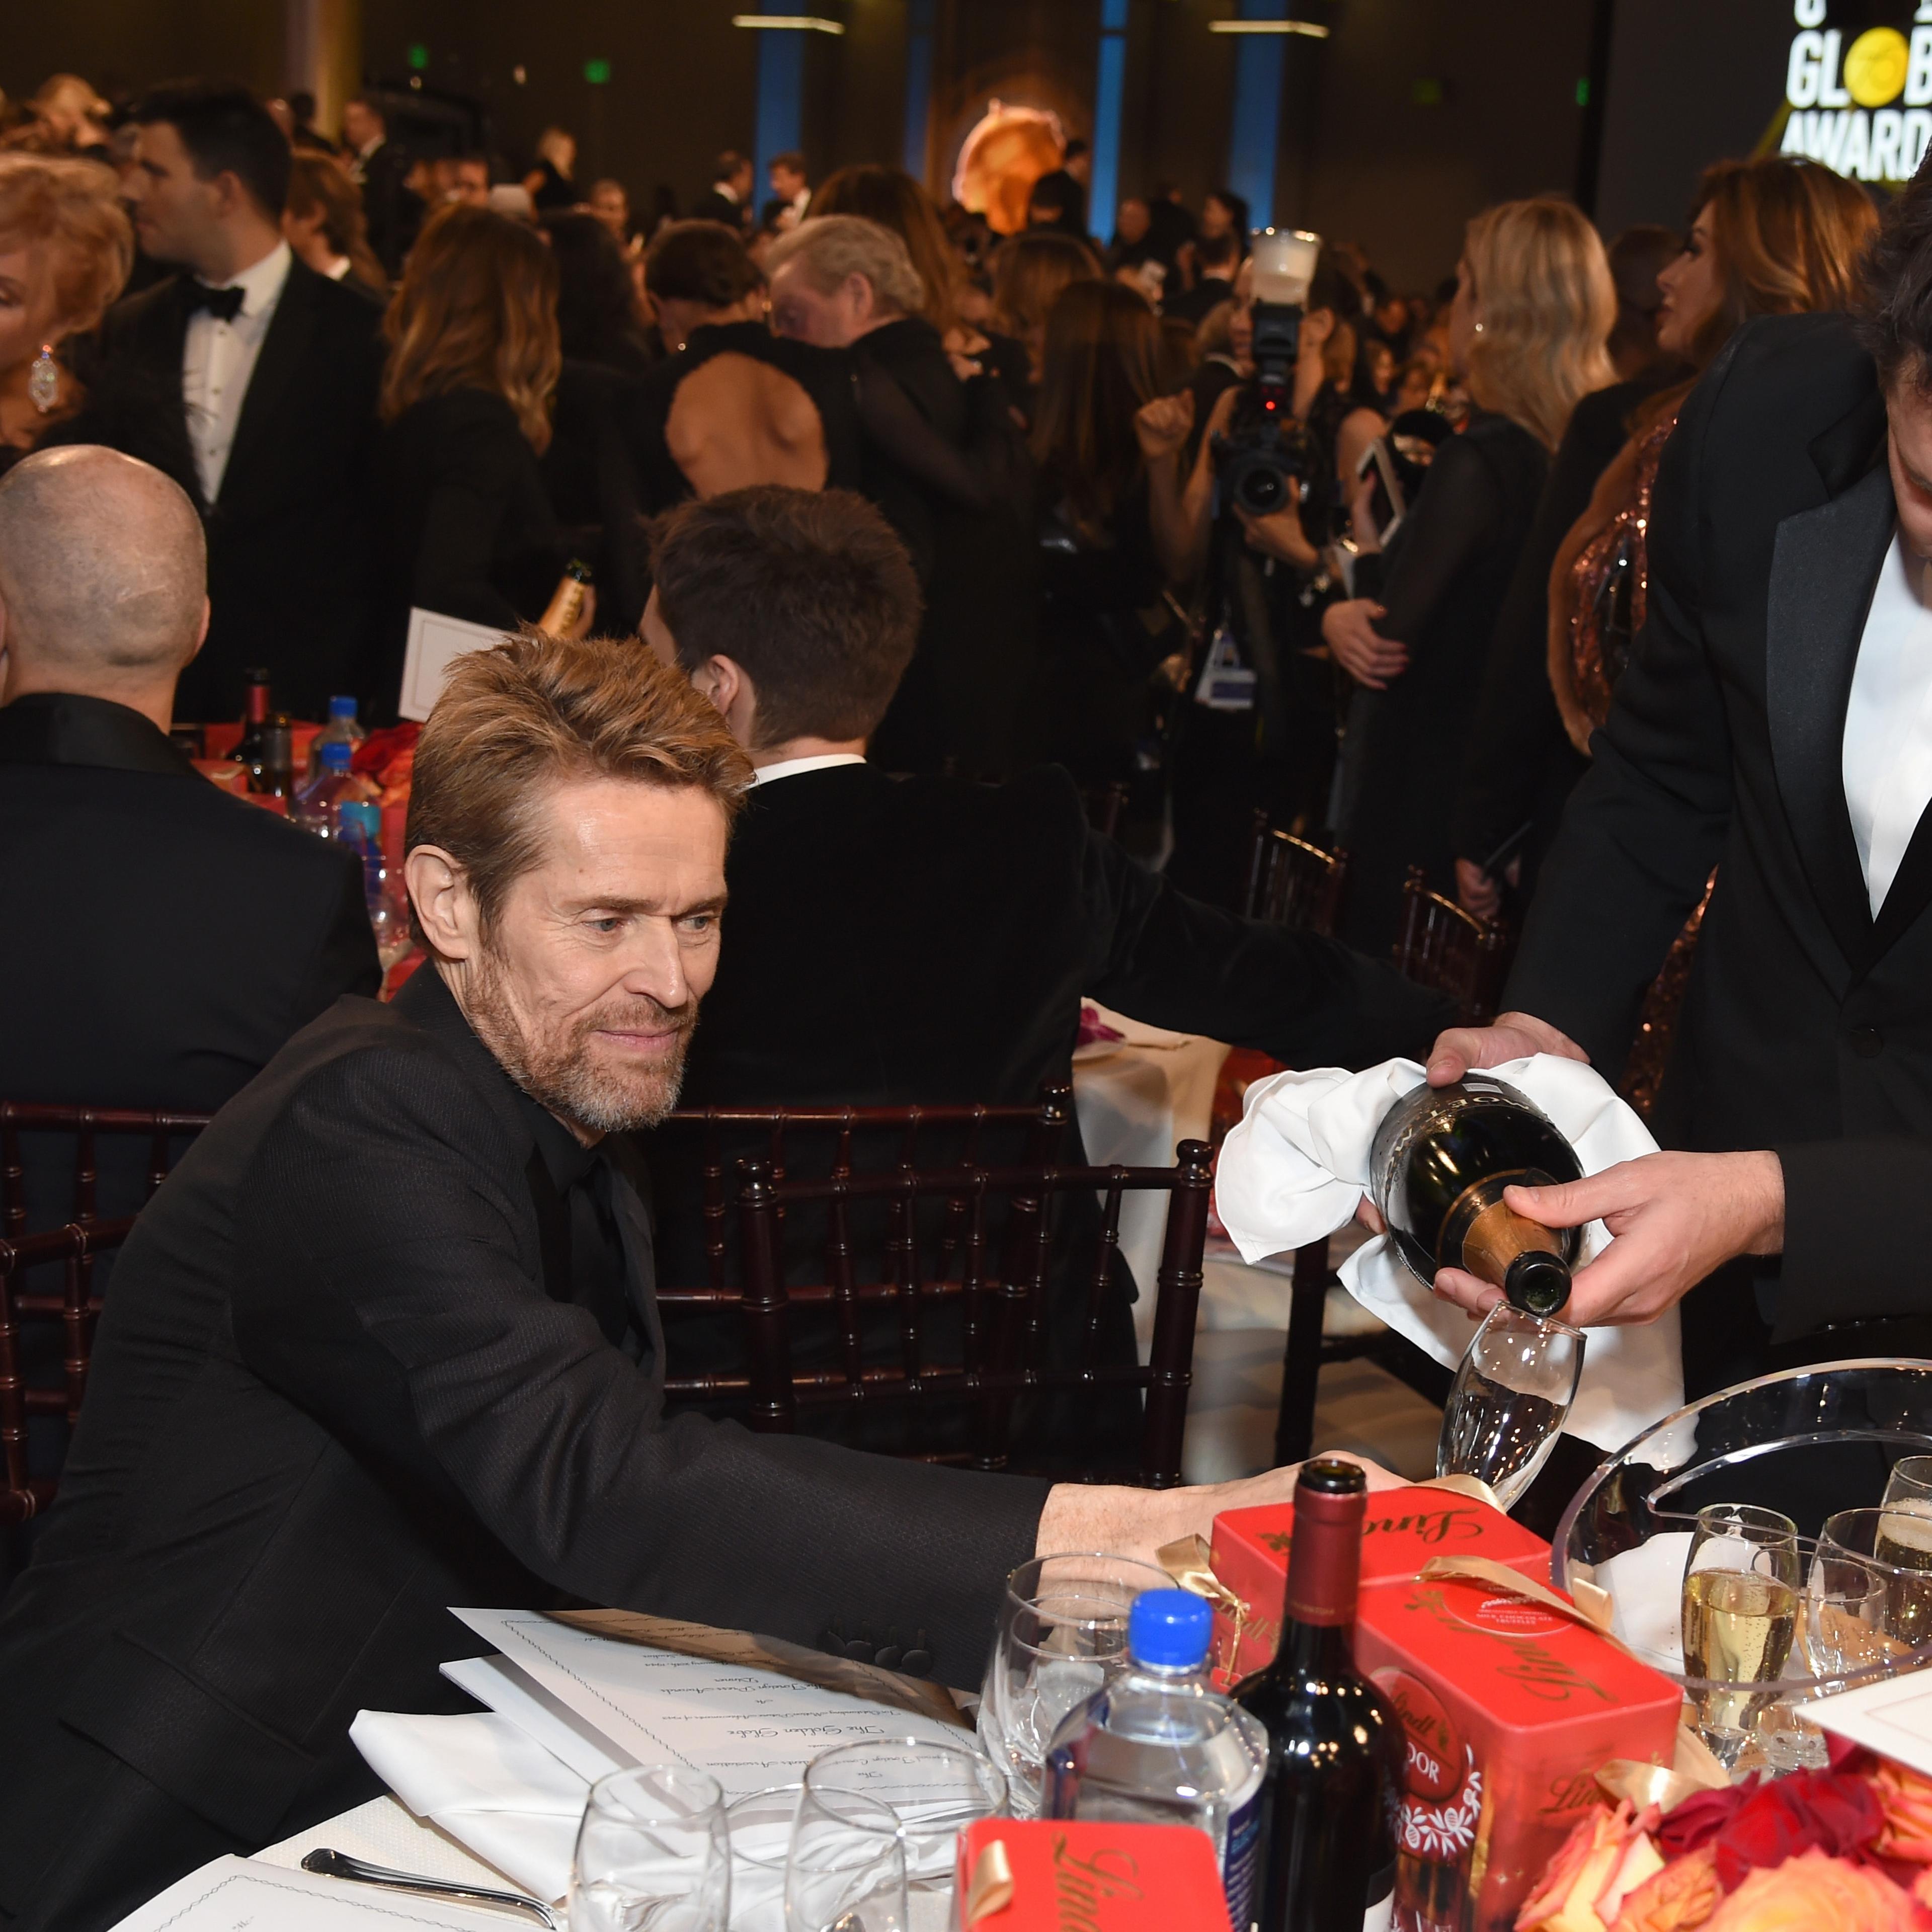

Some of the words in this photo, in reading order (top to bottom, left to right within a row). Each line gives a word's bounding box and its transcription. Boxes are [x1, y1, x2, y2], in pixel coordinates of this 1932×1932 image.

[727, 1727, 779, 1738] Globe
[783, 1725, 842, 1736] Golden
[847, 1725, 885, 1734] The
